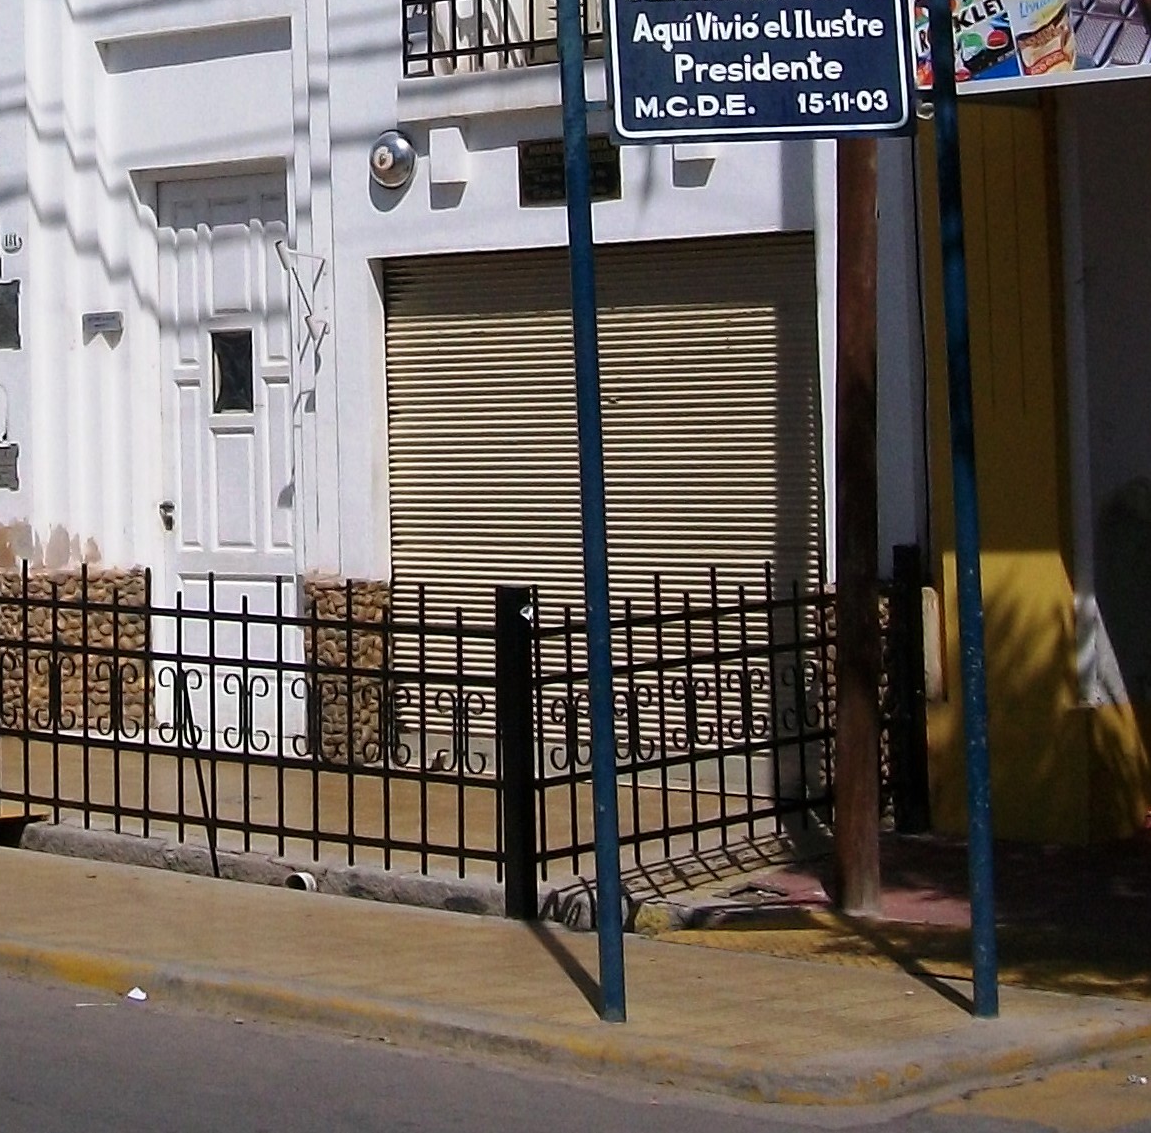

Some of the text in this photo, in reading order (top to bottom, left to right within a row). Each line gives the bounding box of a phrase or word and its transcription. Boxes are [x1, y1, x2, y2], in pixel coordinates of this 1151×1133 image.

[632, 8, 884, 53] Aquí Vivió el Ilustre
[674, 50, 843, 83] Presidente
[635, 94, 756, 119] M.C.D.E.
[797, 89, 889, 114] 15-11-03
